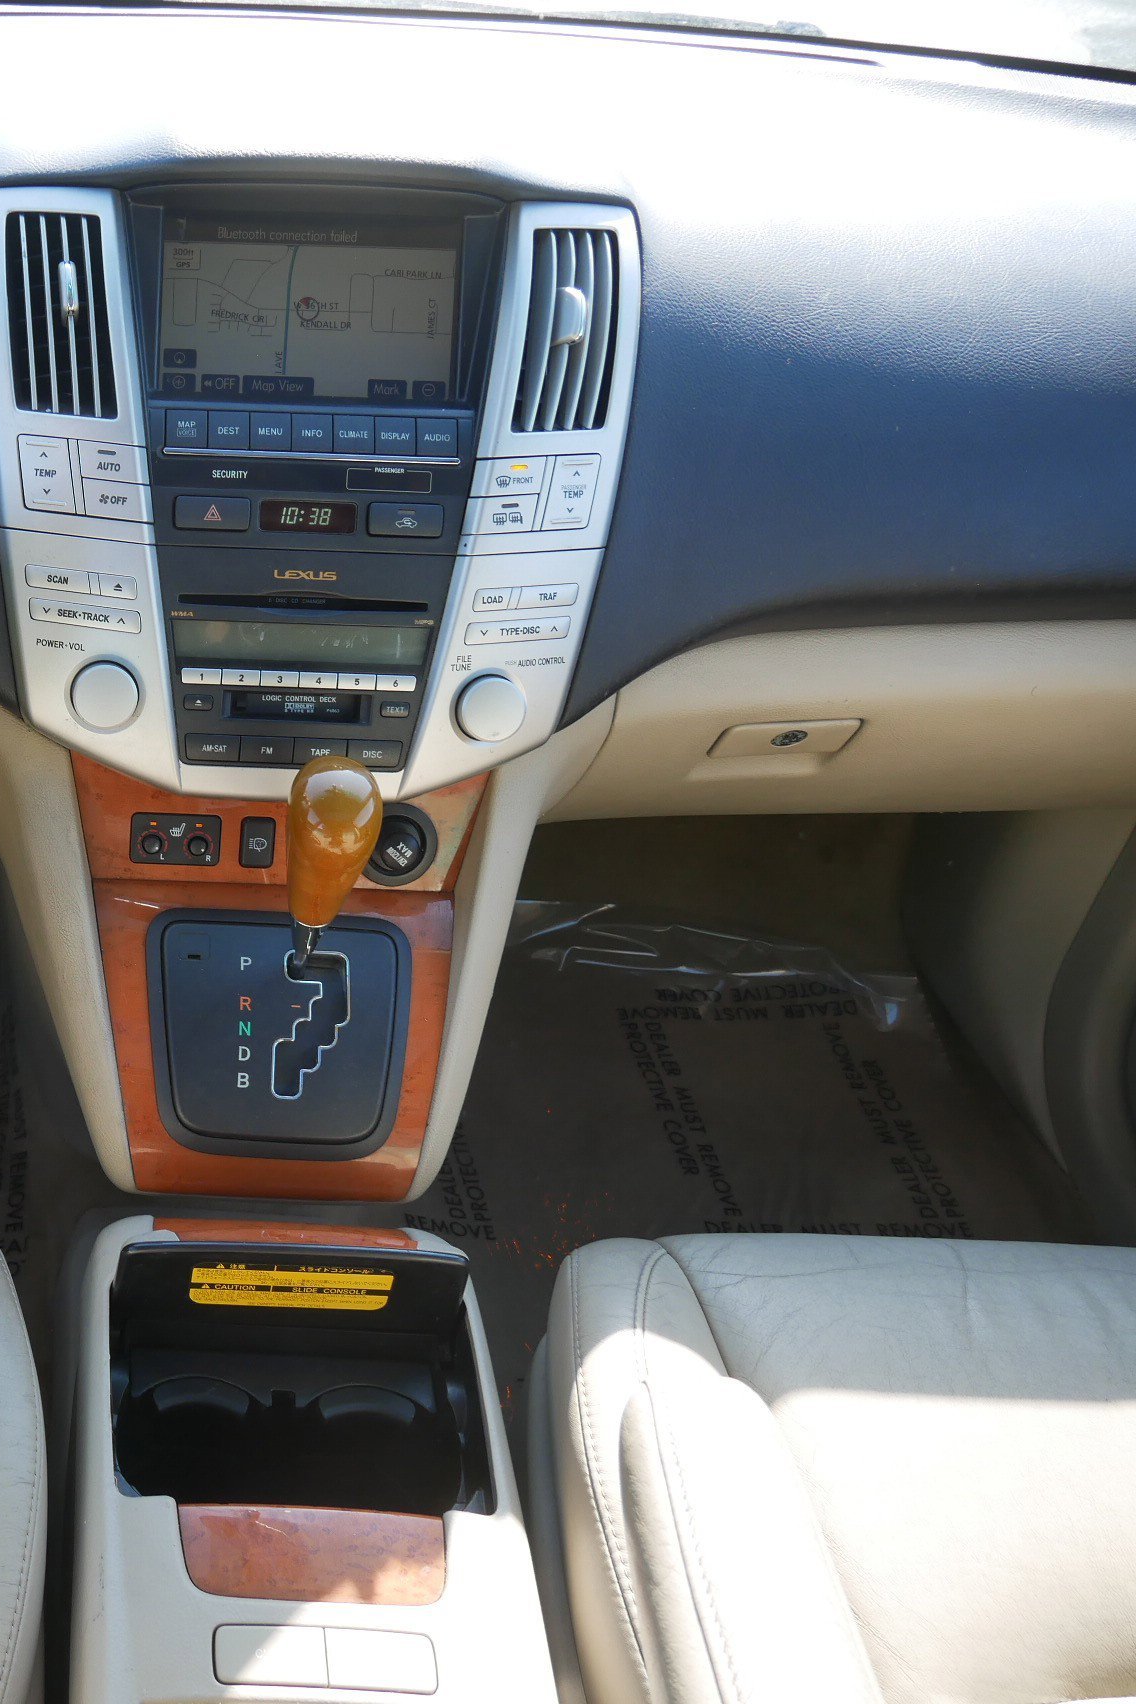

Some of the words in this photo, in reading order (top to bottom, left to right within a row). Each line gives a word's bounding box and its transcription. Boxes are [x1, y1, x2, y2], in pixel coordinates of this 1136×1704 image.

[217, 225, 266, 240] Bluetooth
[269, 228, 327, 242] connection
[329, 230, 358, 244] failed
[176, 260, 191, 268] GPS
[329, 302, 339, 310] ST
[211, 309, 250, 323] FREDRICK
[300, 320, 339, 329] KENDALL
[340, 321, 352, 330] DR
[215, 378, 235, 390] OFF
[252, 380, 275, 393] Map
[278, 381, 303, 392] View
[373, 384, 400, 395] Mark
[177, 420, 196, 428] MAP
[217, 426, 240, 436] DEST
[258, 427, 283, 436] MENU
[301, 429, 323, 438] INFO
[339, 430, 368, 439] CLIMATE
[381, 431, 410, 441] DISPLAY
[424, 433, 451, 442] AUDIO
[97, 461, 121, 473] AUTO
[374, 466, 405, 475] PASSENGER
[34, 468, 57, 478] TEMP
[212, 469, 248, 479] SECURITY
[512, 476, 534, 485] FRONT
[563, 490, 584, 499] TEMP
[110, 495, 128, 506] OFF
[280, 507, 332, 526] 10:38
[47, 574, 69, 585] SCAN
[273, 569, 337, 581] LEXUS
[482, 595, 504, 604] LOAD
[539, 592, 558, 602] TRAF
[456, 655, 472, 664] FILE
[517, 658, 537, 667] AUDIO
[537, 656, 566, 666] CONTROL
[450, 663, 472, 672] TUNE
[199, 673, 204, 681] 1
[238, 674, 244, 682] 2
[277, 675, 283, 683] 3
[315, 677, 322, 685] 4
[354, 678, 360, 686] 5
[392, 679, 399, 688] 6
[262, 694, 283, 702] LOGIC
[285, 695, 316, 703] CONTROL
[319, 696, 337, 704] DECK
[385, 706, 405, 714] TEXT
[261, 746, 273, 755] FM
[362, 749, 383, 759] DISC
[396, 841, 413, 858] MAX
[159, 853, 165, 861] L
[205, 854, 211, 862] R
[240, 956, 252, 971] P
[240, 996, 252, 1011] R
[714, 1006, 769, 1021] MUST
[782, 999, 858, 1019] DEALER
[238, 1022, 251, 1036] N
[238, 1046, 251, 1061] D
[822, 1022, 867, 1090] REMOVE
[237, 1073, 250, 1088] B
[861, 1059, 903, 1112] COVER
[620, 1022, 675, 1113] PROTECTIVE
[662, 1119, 700, 1177] COVER
[644, 1022, 682, 1078] DEALER
[673, 1086, 707, 1136] MUST
[696, 1143, 743, 1218] REMOVE
[857, 1096, 897, 1145] MUST
[894, 1119, 964, 1218] PROTECTIVE
[5, 1150, 28, 1235] REMOVE
[891, 1157, 939, 1219] DEALER
[404, 1213, 497, 1241] REMOVE
[703, 1221, 784, 1233] DEALER
[800, 1222, 863, 1235] MUST
[876, 1222, 975, 1238] REMOVE
